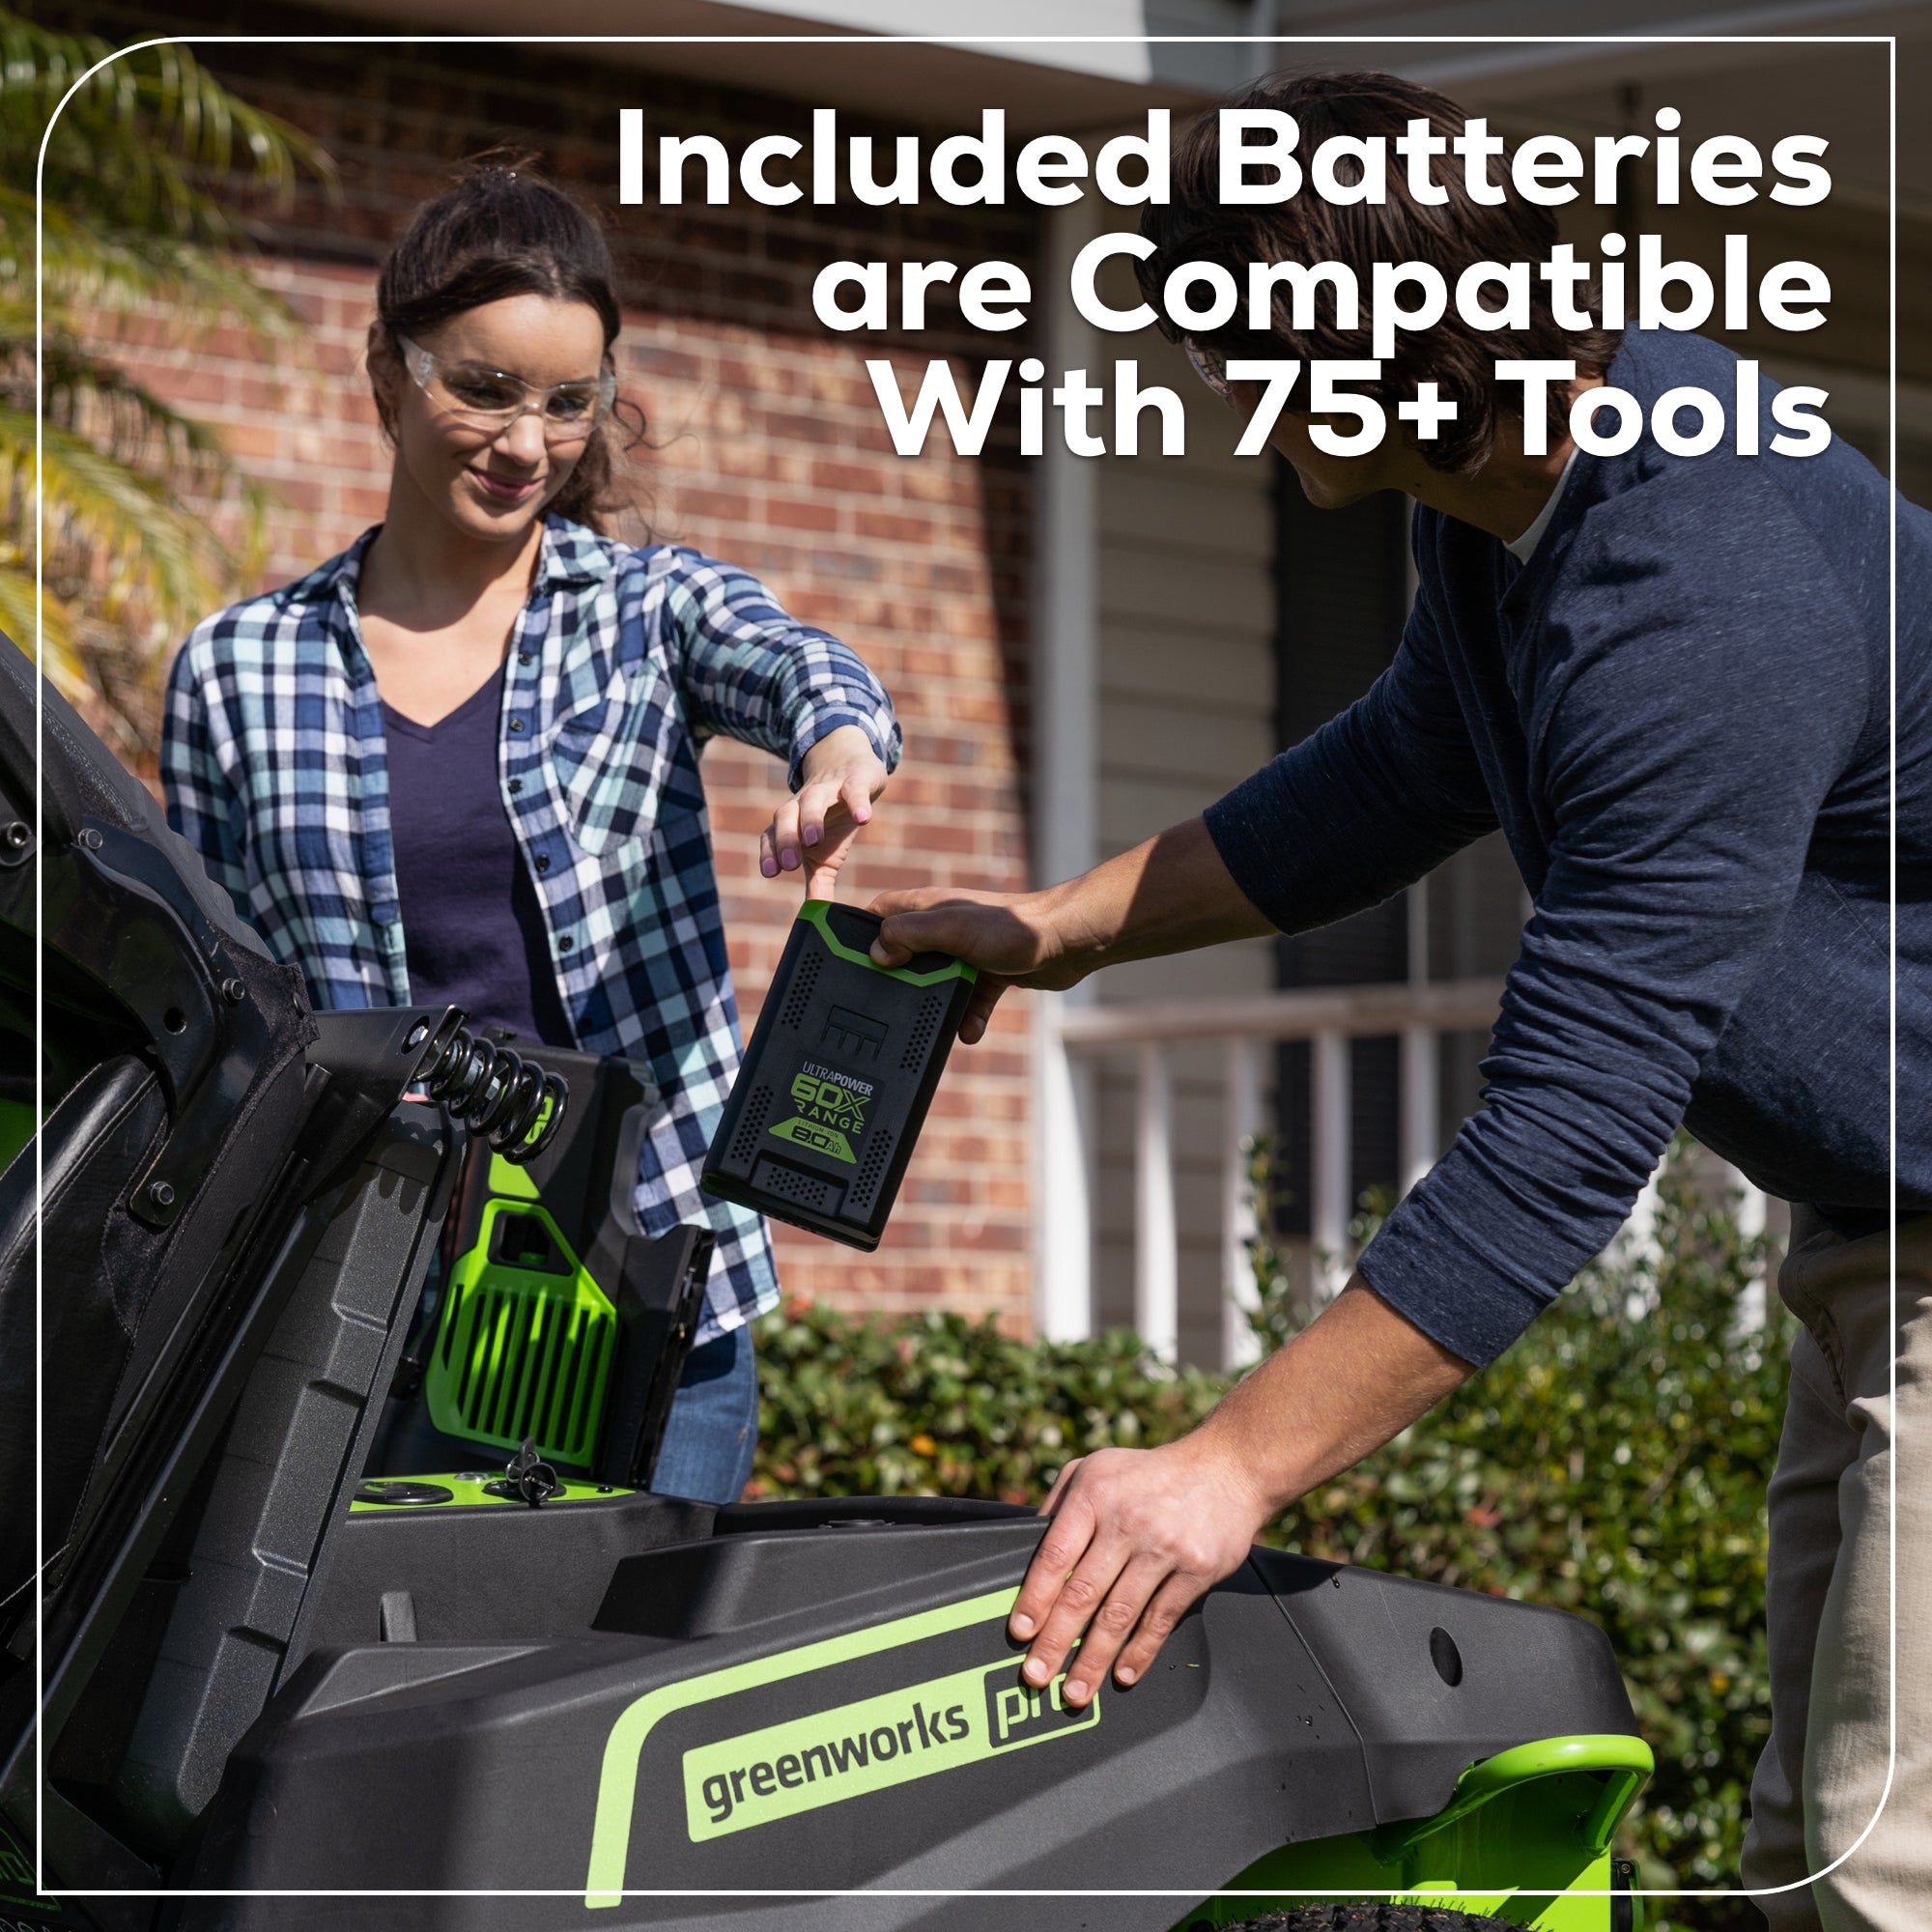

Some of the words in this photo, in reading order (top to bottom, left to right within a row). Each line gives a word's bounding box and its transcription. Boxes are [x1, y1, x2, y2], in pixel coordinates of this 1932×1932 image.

[790, 1072, 871, 1122] 60X
[802, 1061, 873, 1096] ULTRAPOWER
[794, 1098, 865, 1135] RANGE
[701, 1702, 970, 1824] greenworks
